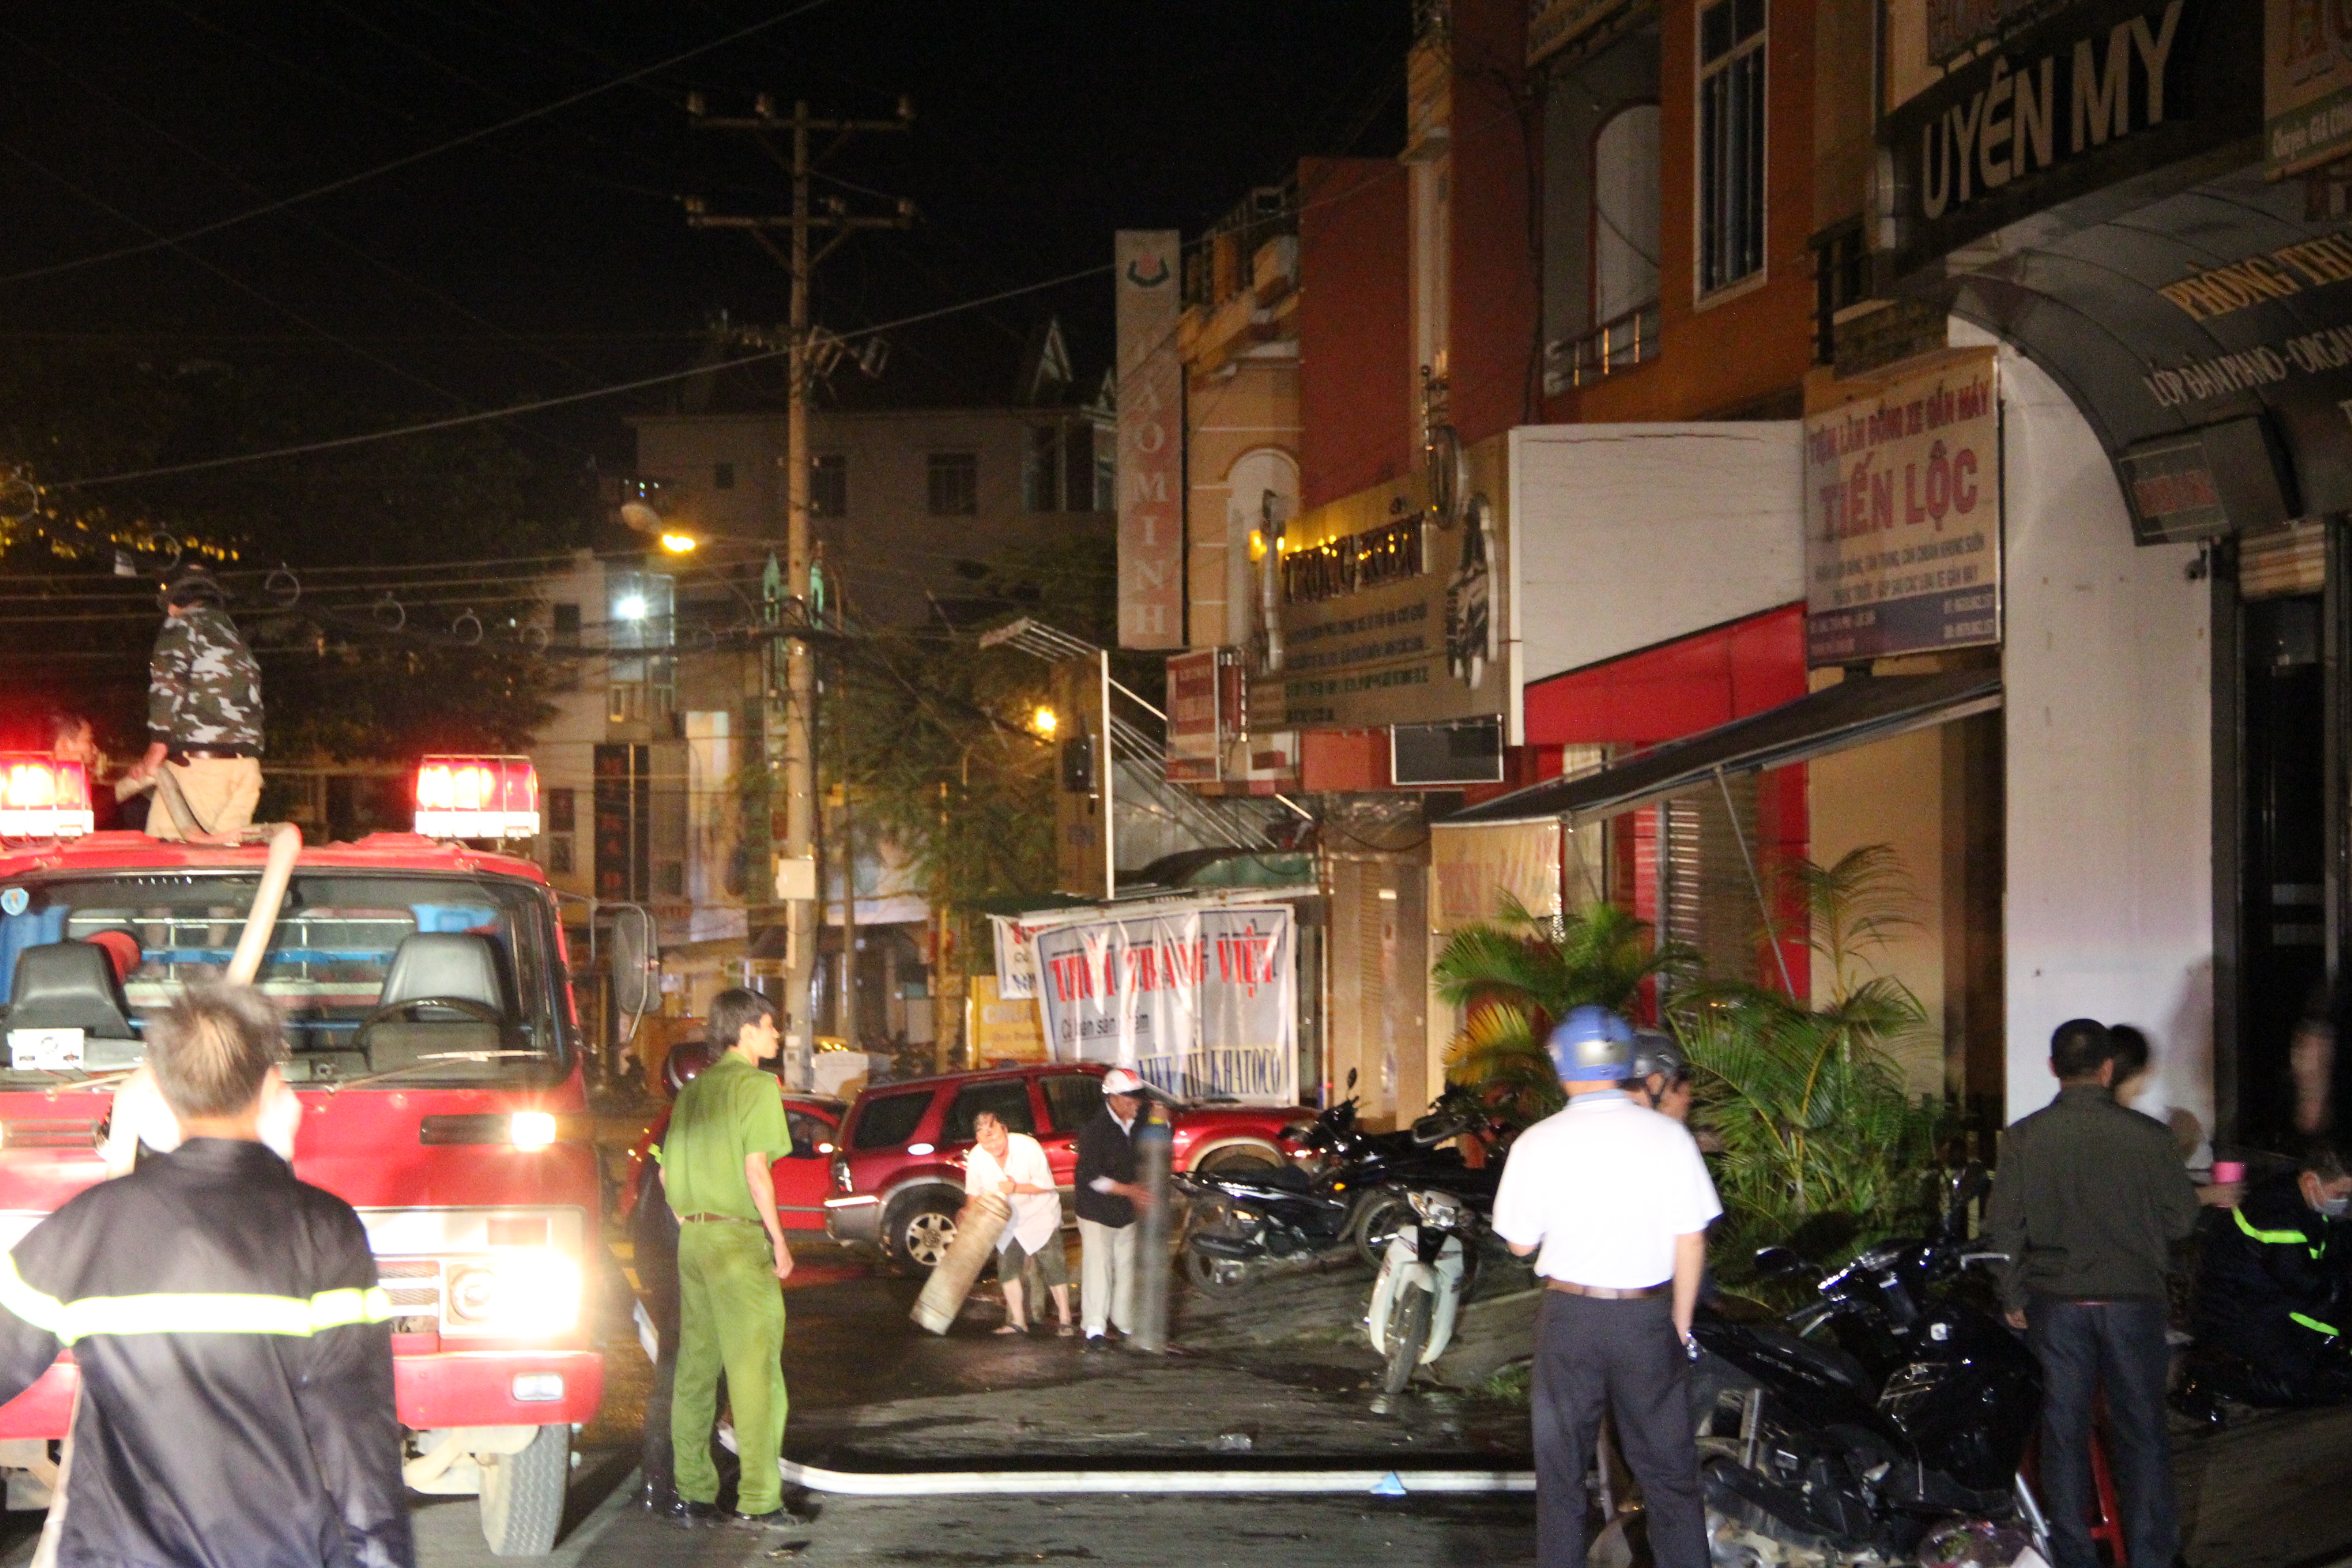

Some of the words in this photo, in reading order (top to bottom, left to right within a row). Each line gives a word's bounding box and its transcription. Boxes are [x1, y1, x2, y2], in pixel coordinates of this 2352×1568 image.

[1923, 54, 2054, 220] UYÊN
[2072, 1, 2183, 154] MY
[2157, 259, 2303, 321] PHÒNG
[2272, 233, 2352, 285] TH
[1818, 451, 1894, 541] TIẾN
[1906, 439, 1978, 531] LỘC
[1211, 1047, 1281, 1096] KHATOCO
